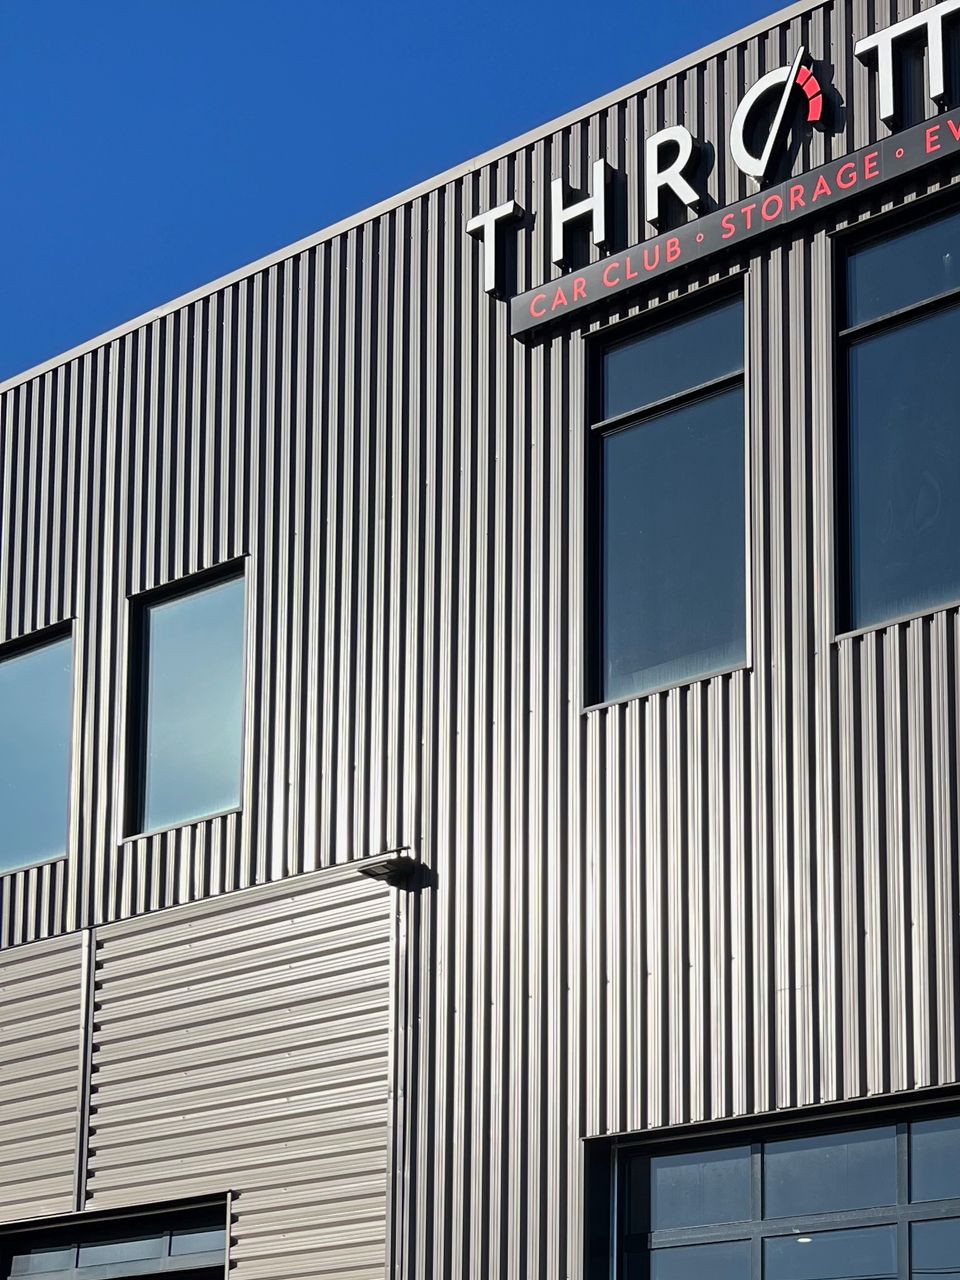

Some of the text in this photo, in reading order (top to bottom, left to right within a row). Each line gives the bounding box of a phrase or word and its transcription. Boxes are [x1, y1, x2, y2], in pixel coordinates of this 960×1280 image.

[529, 277, 587, 318] CAR
[602, 238, 681, 288] CLUB
[721, 151, 880, 239] STORAGE
